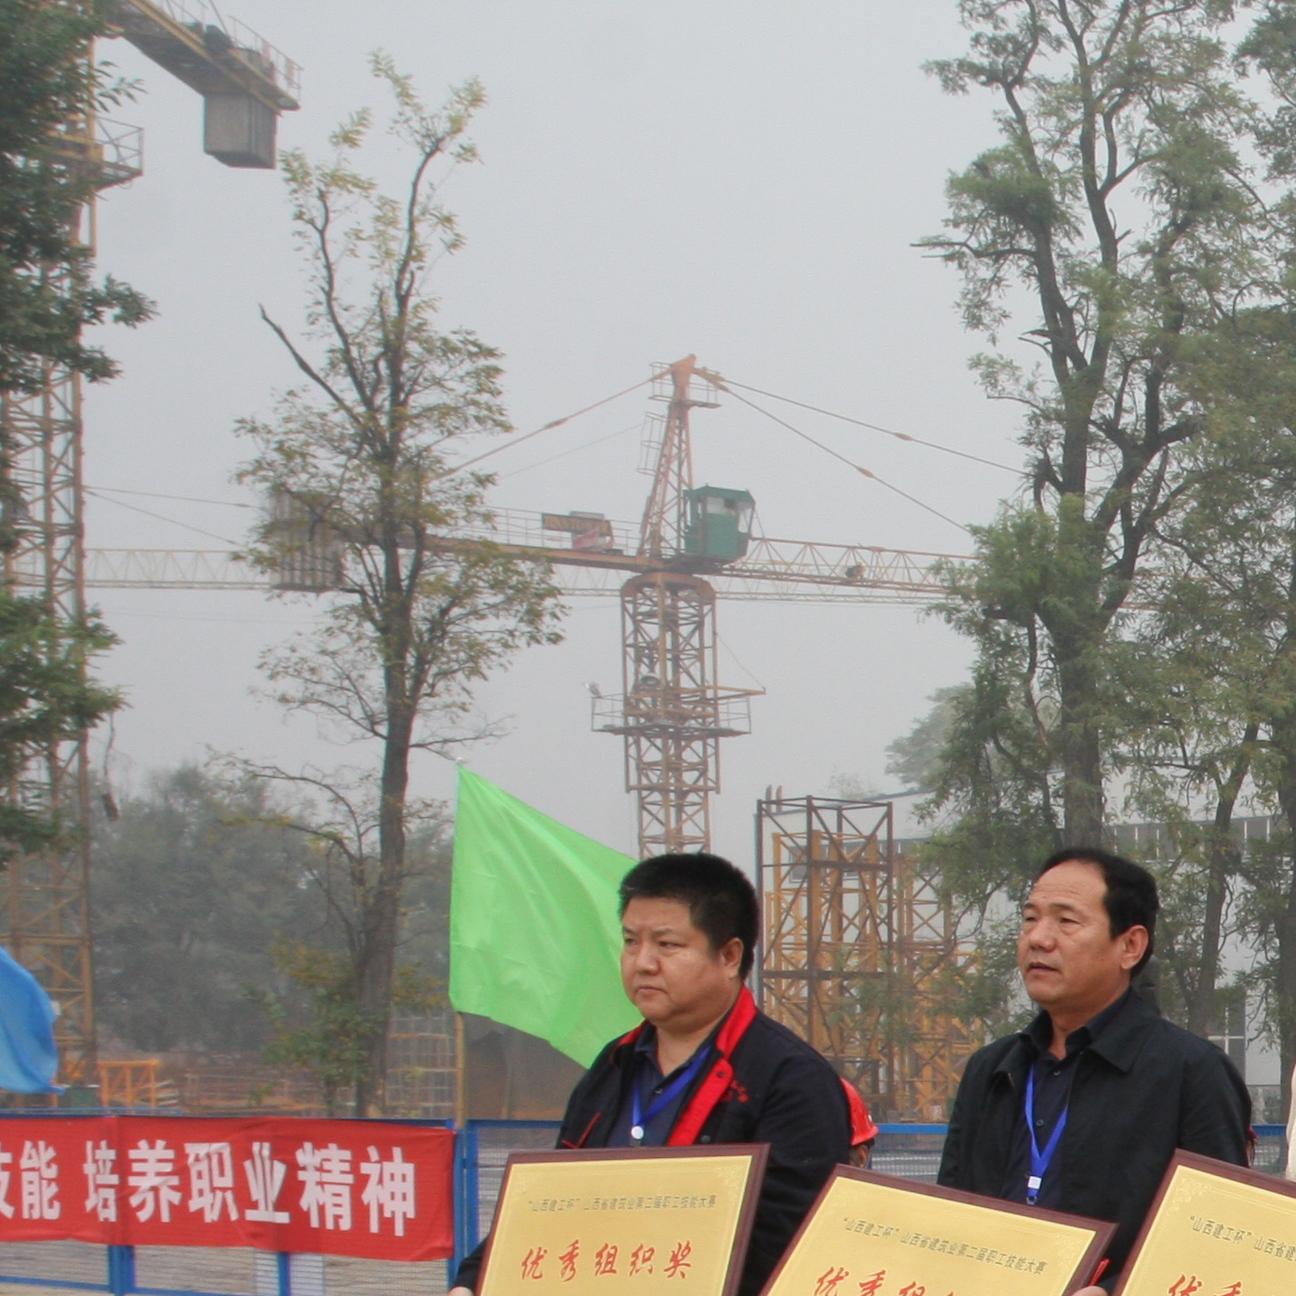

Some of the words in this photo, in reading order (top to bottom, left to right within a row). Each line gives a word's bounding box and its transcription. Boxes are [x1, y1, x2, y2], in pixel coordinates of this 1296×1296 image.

[83, 1139, 416, 1237] 培养职业精神
[521, 1239, 692, 1282] 优秀组织奖
